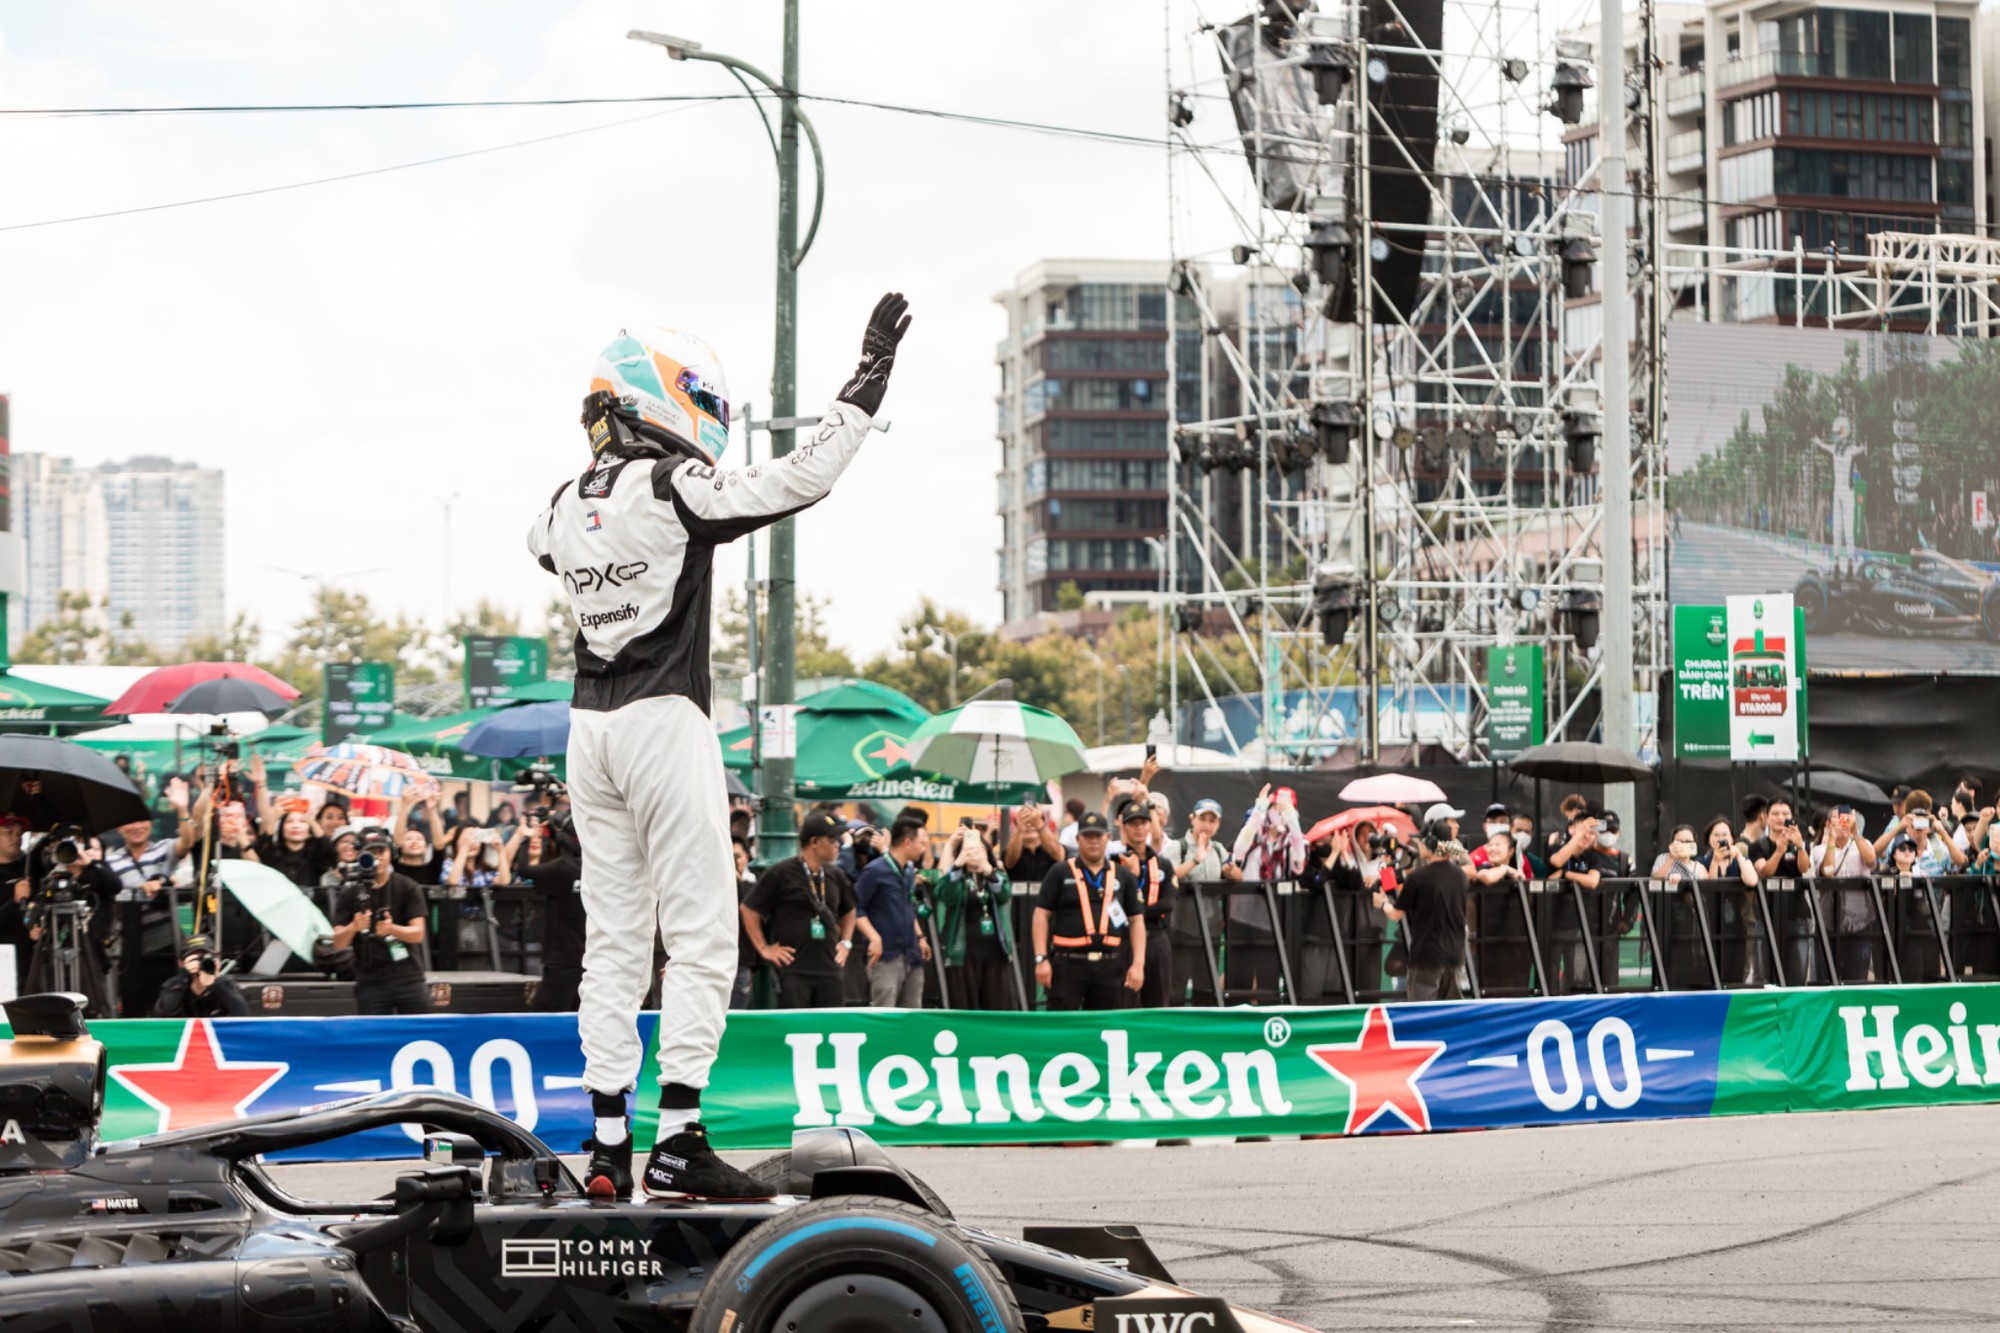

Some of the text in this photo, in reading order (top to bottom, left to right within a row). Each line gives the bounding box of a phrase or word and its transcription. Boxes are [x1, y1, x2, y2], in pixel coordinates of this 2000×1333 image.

[580, 602, 640, 630] Expensify
[1680, 681, 1724, 700] TRÊN
[107, 1198, 138, 1209] HAYES
[562, 1239, 653, 1256] TOMMY
[562, 1260, 663, 1276] HILFIGER
